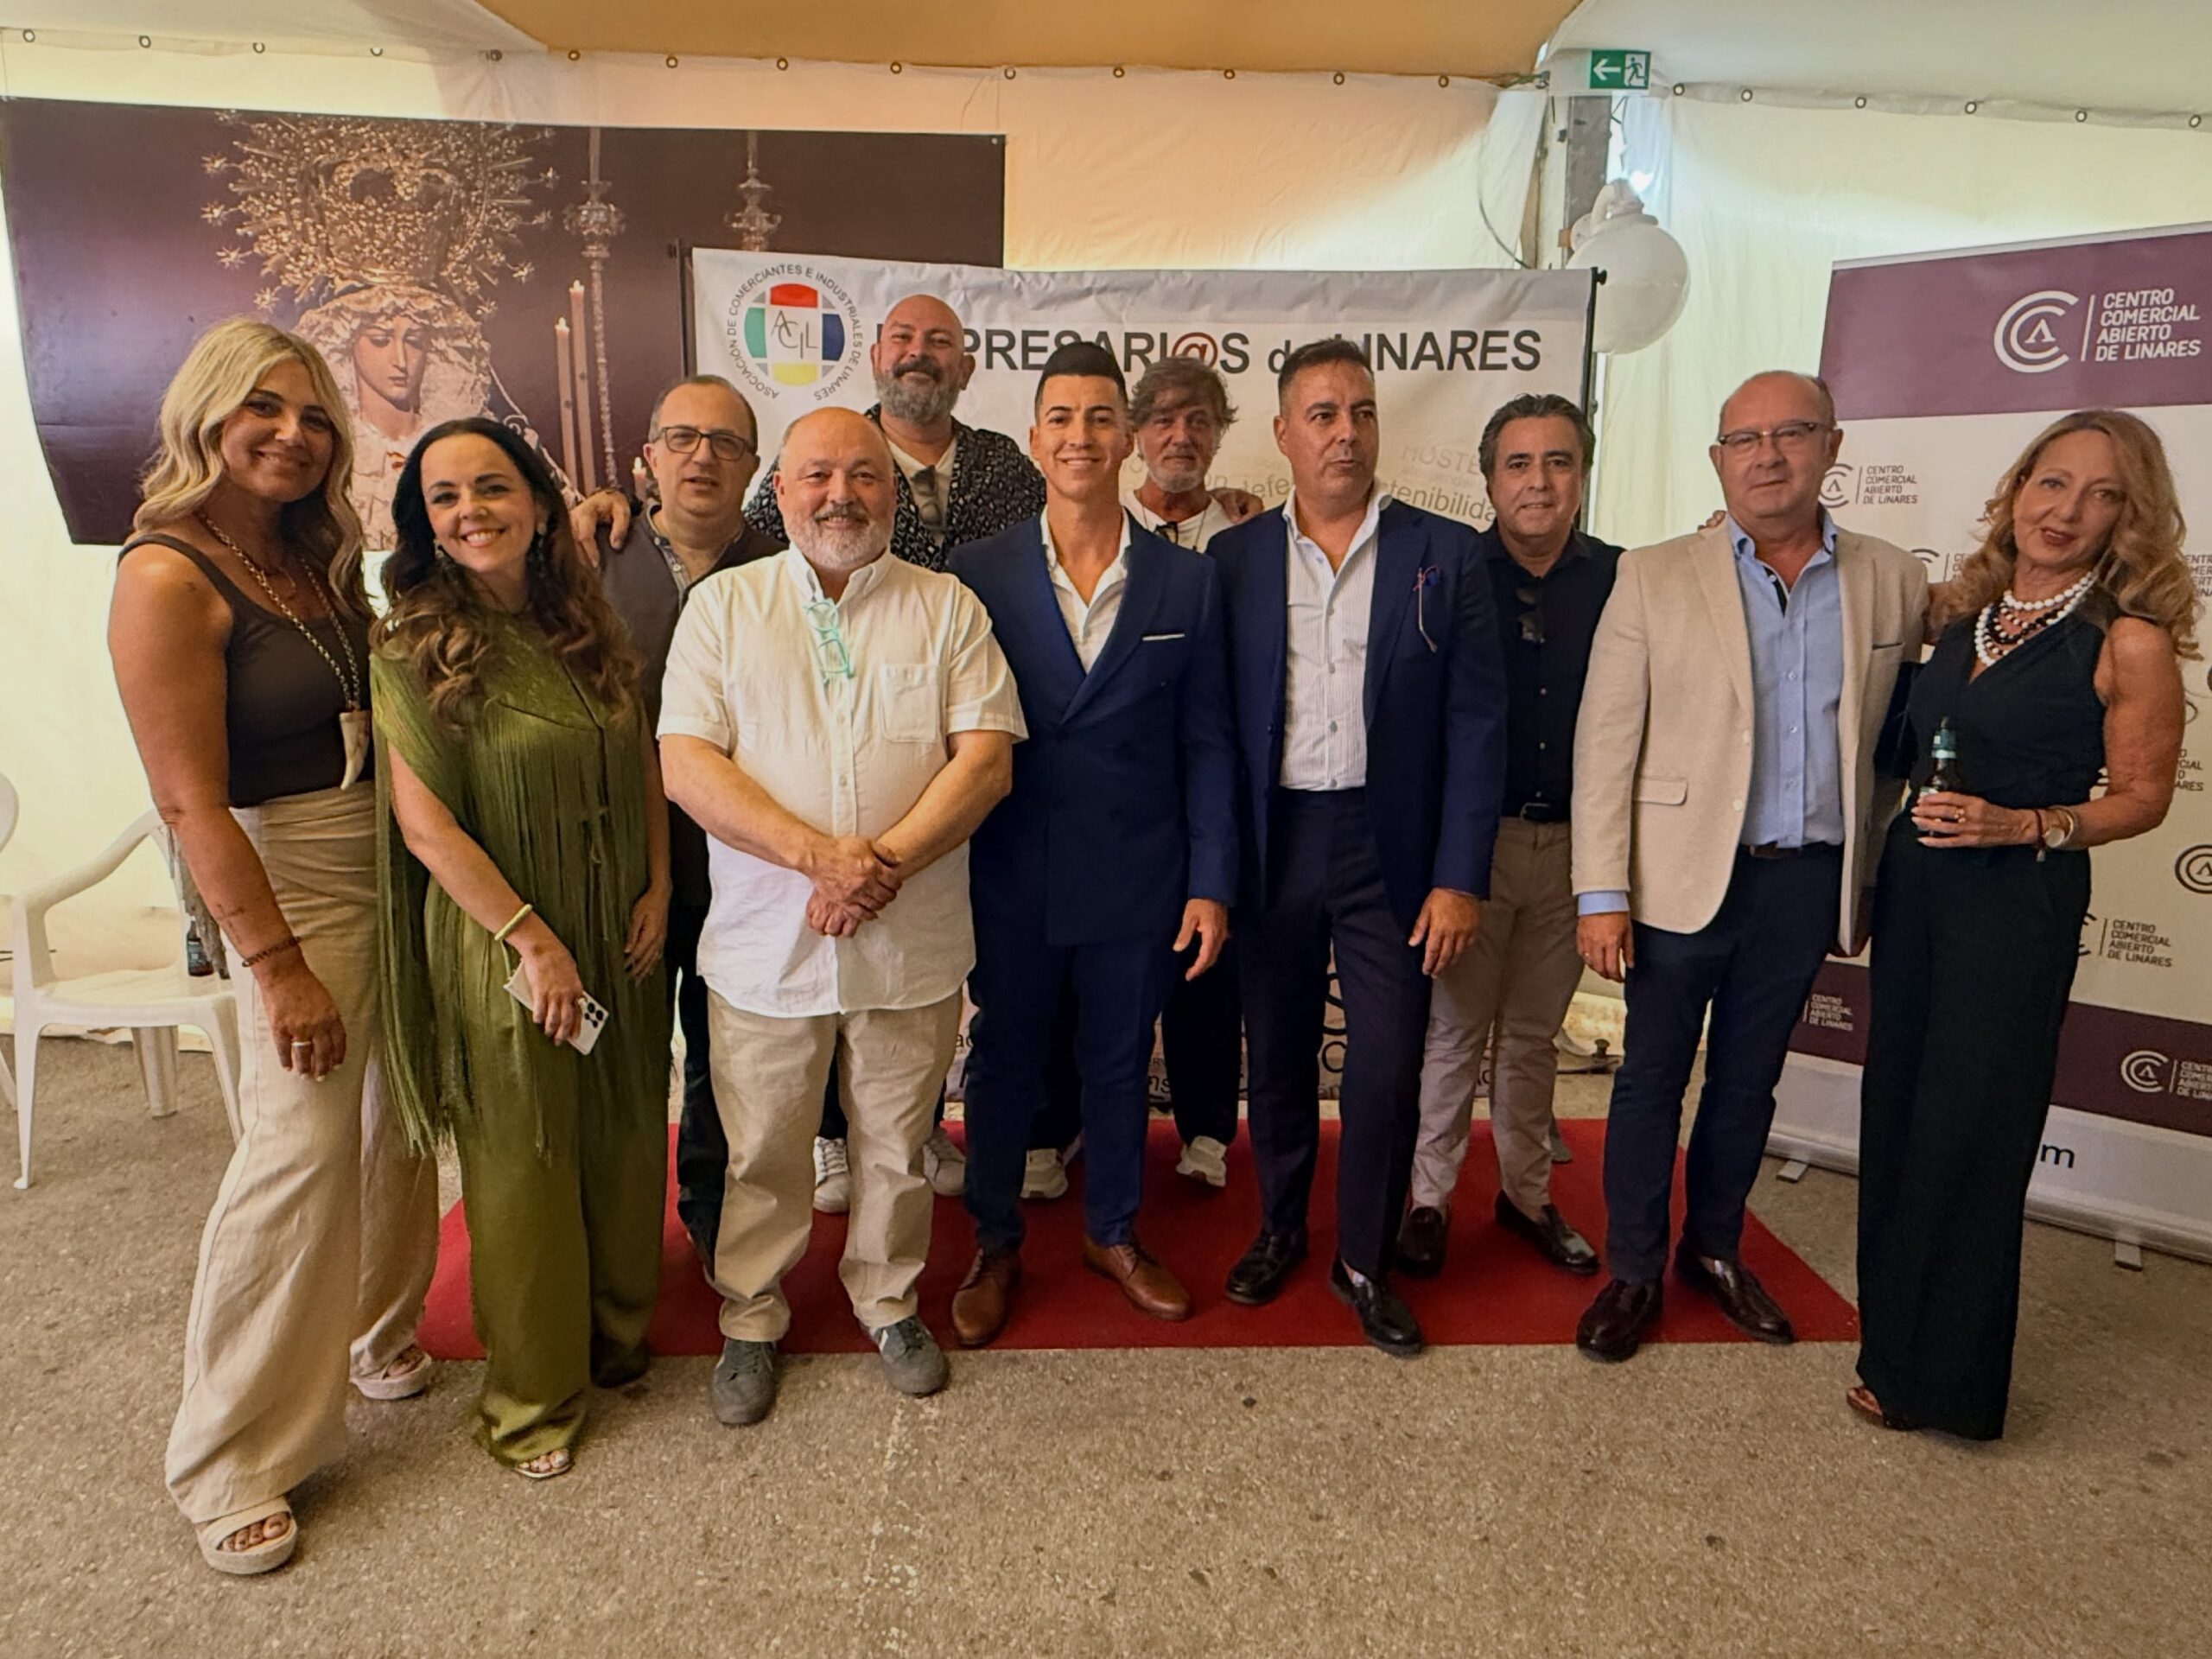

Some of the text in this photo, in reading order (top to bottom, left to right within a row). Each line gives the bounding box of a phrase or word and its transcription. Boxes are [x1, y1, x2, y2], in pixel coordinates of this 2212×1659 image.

[805, 267, 814, 277] E
[728, 264, 803, 315] COMERCIANTES
[2103, 289, 2174, 309] CENTRO
[816, 271, 862, 347] INDUSTRIALES
[2101, 304, 2201, 327] COMERCIAL
[728, 319, 736, 335] DE
[2096, 324, 2171, 344] ABIERTO
[876, 323, 1249, 373] PREARI@S
[1335, 330, 1541, 372] INARES
[2094, 340, 2202, 361] DE LINARES
[849, 350, 861, 365] DE
[814, 365, 854, 400] LINARES
[1402, 443, 1479, 474] HOSTE
[1866, 465, 1904, 474] CENTRO
[1866, 474, 1917, 485] COMERCIAL
[1864, 485, 1903, 494] ABIERTO
[1863, 495, 1918, 505] DE LINARES
[2113, 919, 2156, 933] CENTRO
[2109, 940, 2155, 954] ABIERTO
[2111, 931, 2171, 947] COMERCIAL
[2107, 950, 2172, 967] DE LINARES
